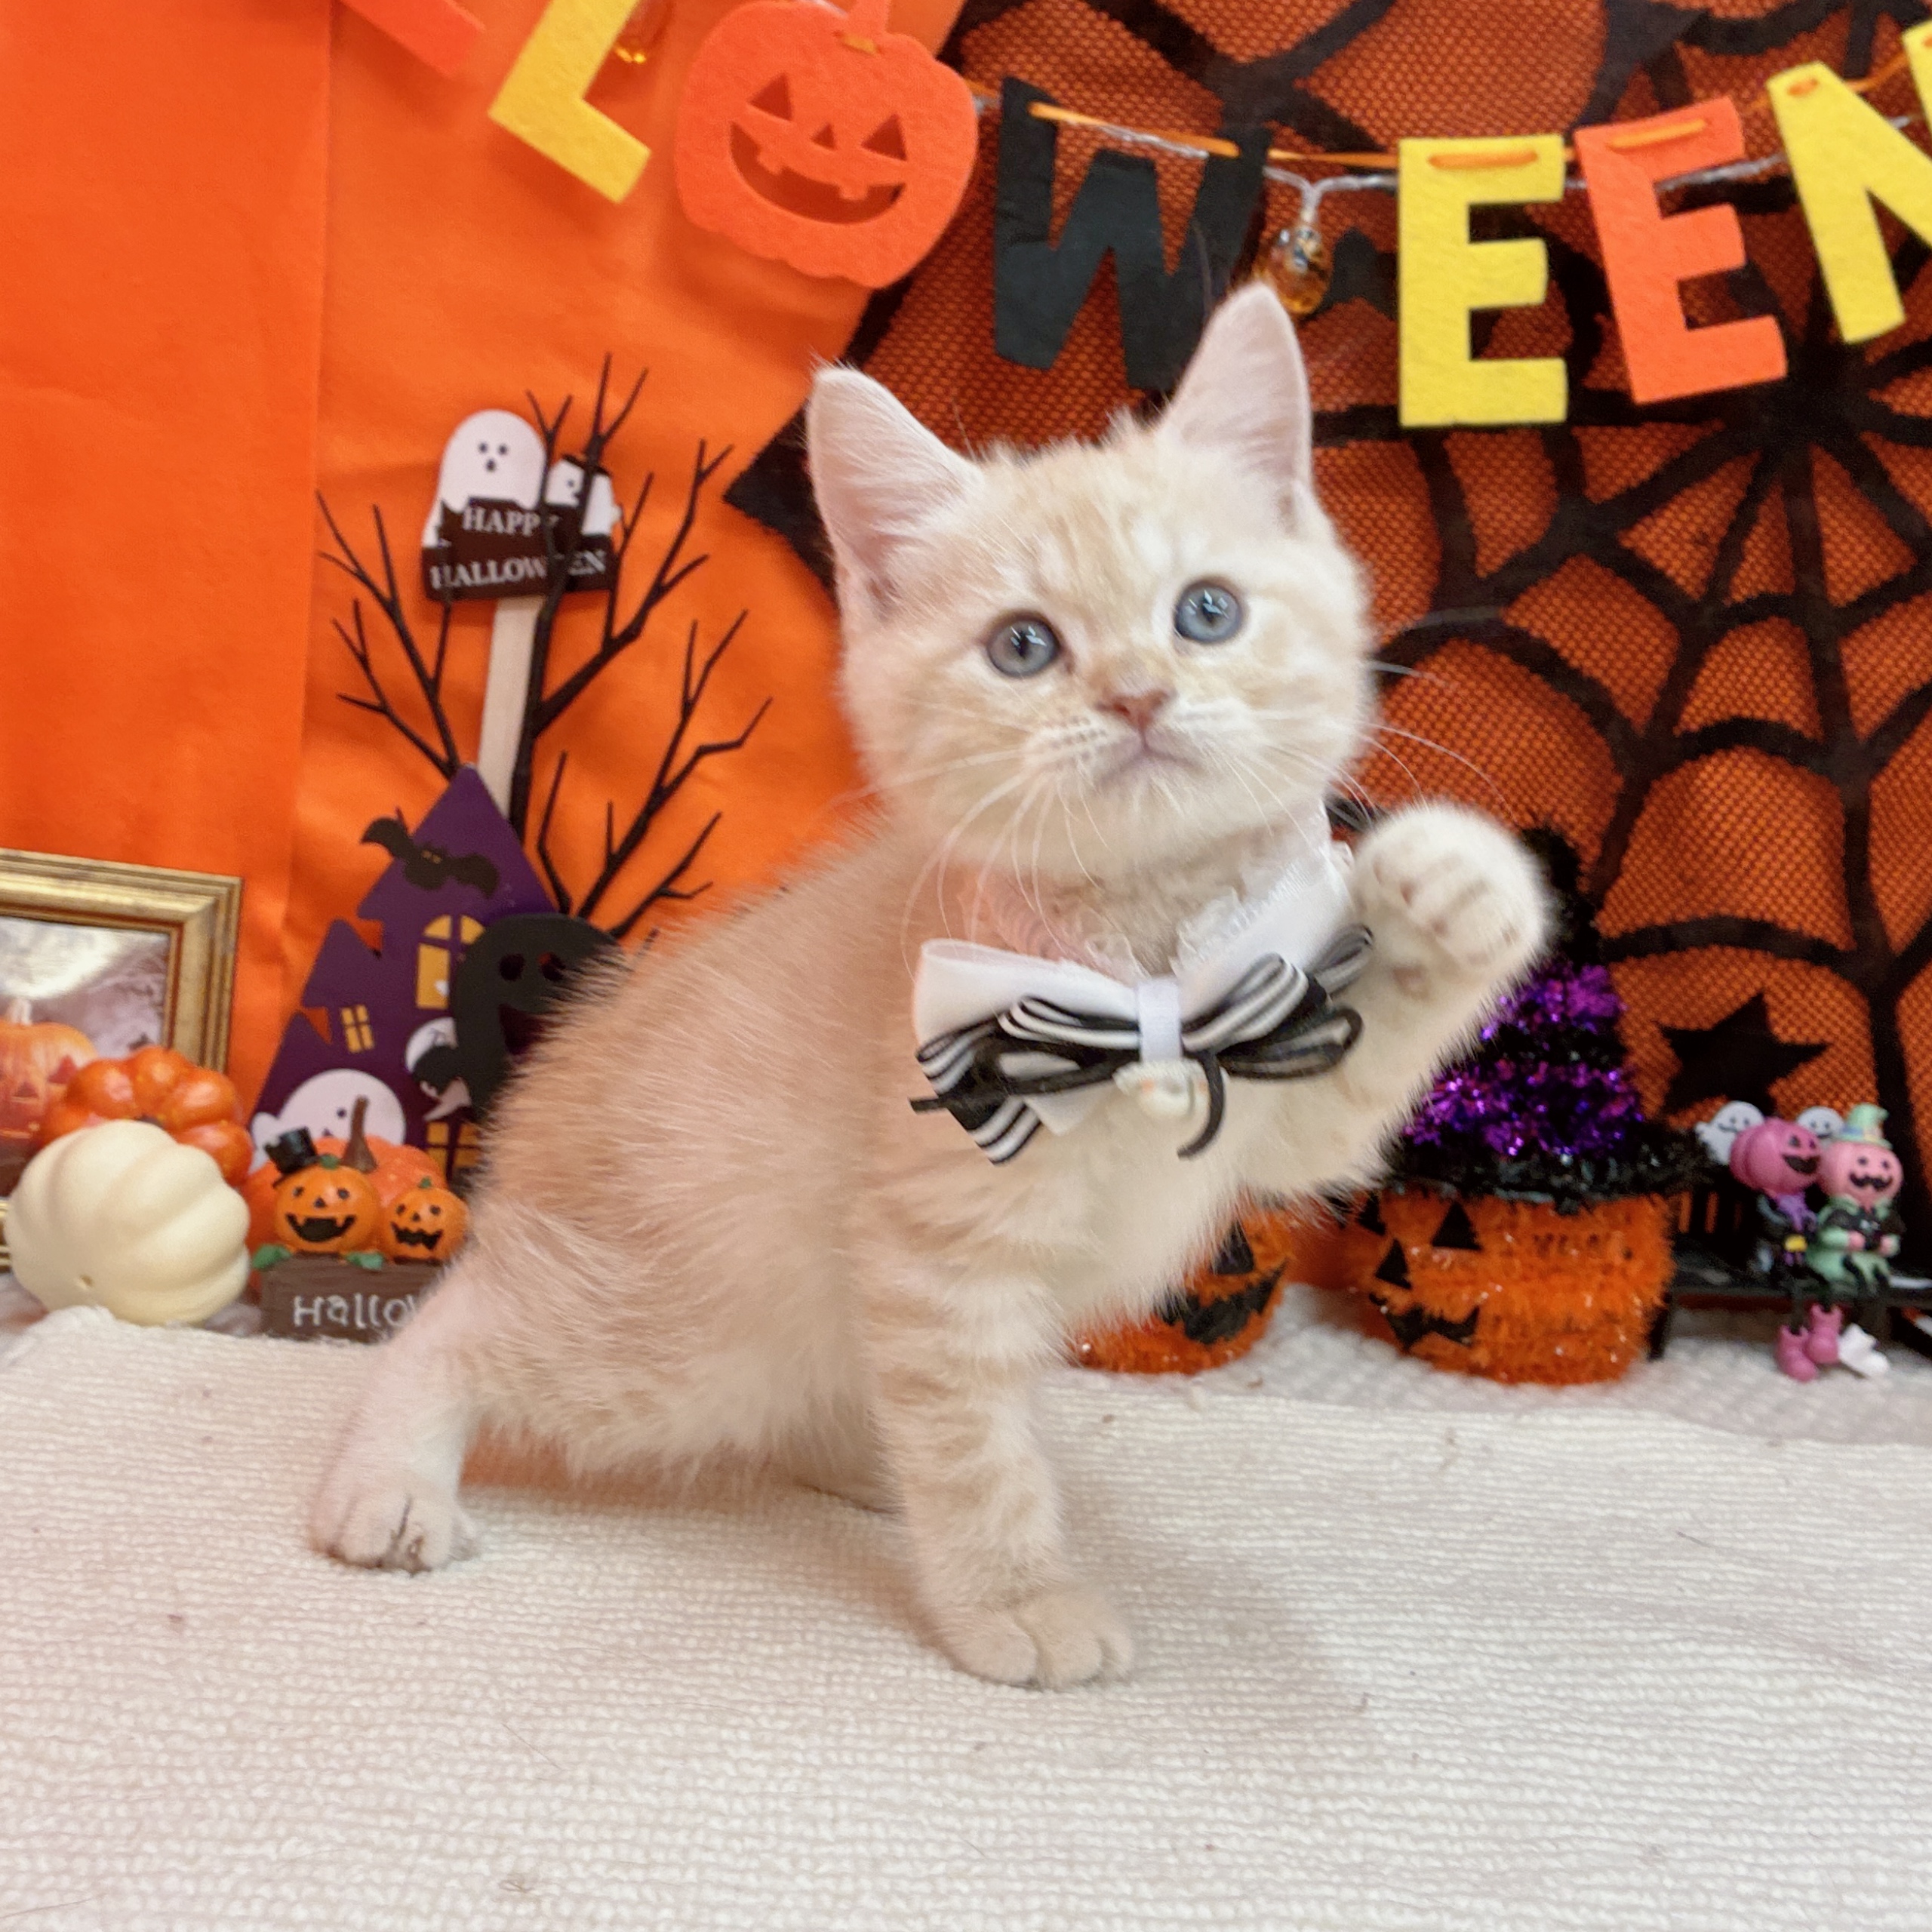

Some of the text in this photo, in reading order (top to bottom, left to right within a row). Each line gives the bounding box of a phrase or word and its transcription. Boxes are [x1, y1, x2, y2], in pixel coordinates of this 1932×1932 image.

[462, 506, 561, 537] HAPP
[429, 548, 606, 590] HALLOWEN
[292, 1293, 415, 1329] Hallo
